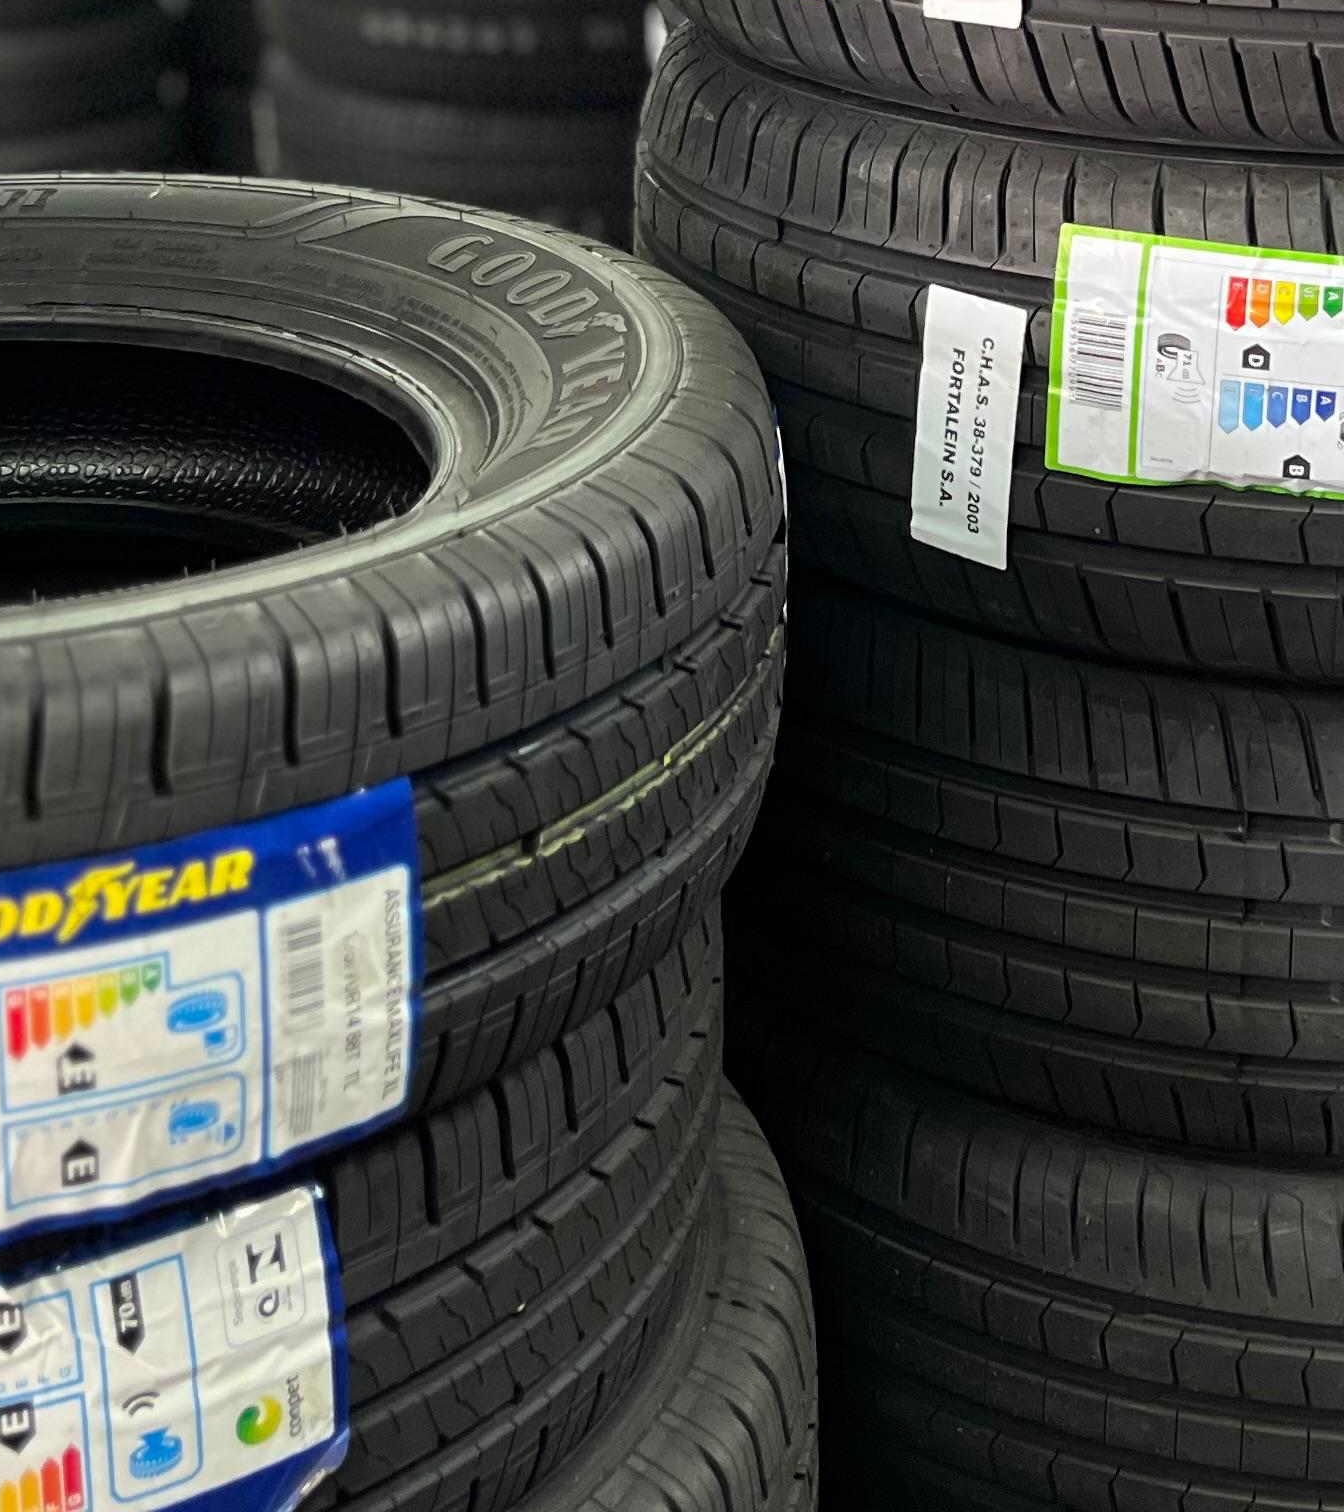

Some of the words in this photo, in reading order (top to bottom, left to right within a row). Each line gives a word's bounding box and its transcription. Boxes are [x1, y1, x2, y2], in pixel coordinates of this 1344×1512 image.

[976, 337, 995, 410] C.H.A.S.
[1248, 354, 1264, 368] D
[942, 347, 965, 465] FORTALEIN
[970, 418, 987, 477] 38-379
[939, 469, 954, 508] S.A.
[967, 491, 981, 535] 2003
[67, 1157, 95, 1181] E
[1, 1409, 30, 1436] E
[286, 1374, 304, 1439] conpet
